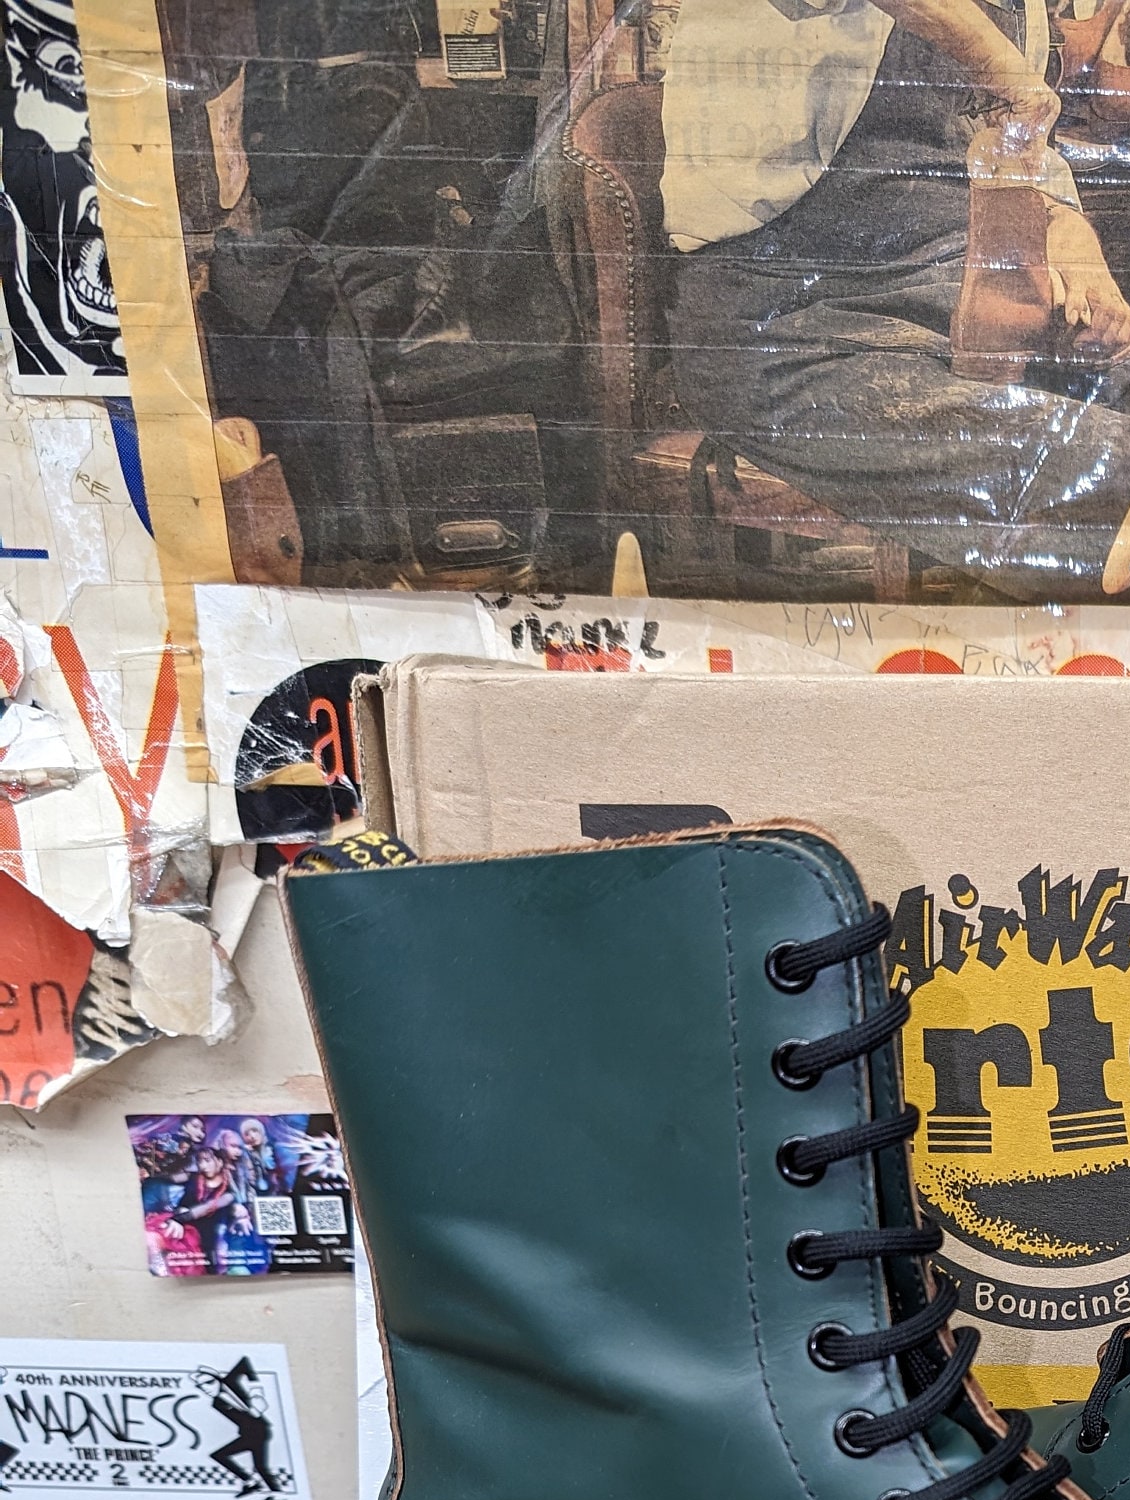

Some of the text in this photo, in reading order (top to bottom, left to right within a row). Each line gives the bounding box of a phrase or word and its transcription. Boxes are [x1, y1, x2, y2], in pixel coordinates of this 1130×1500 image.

[15, 1373, 183, 1388] 40th ANNIVERSARY
[4, 1389, 201, 1450] MADNESS
[109, 1463, 127, 1479] 2
